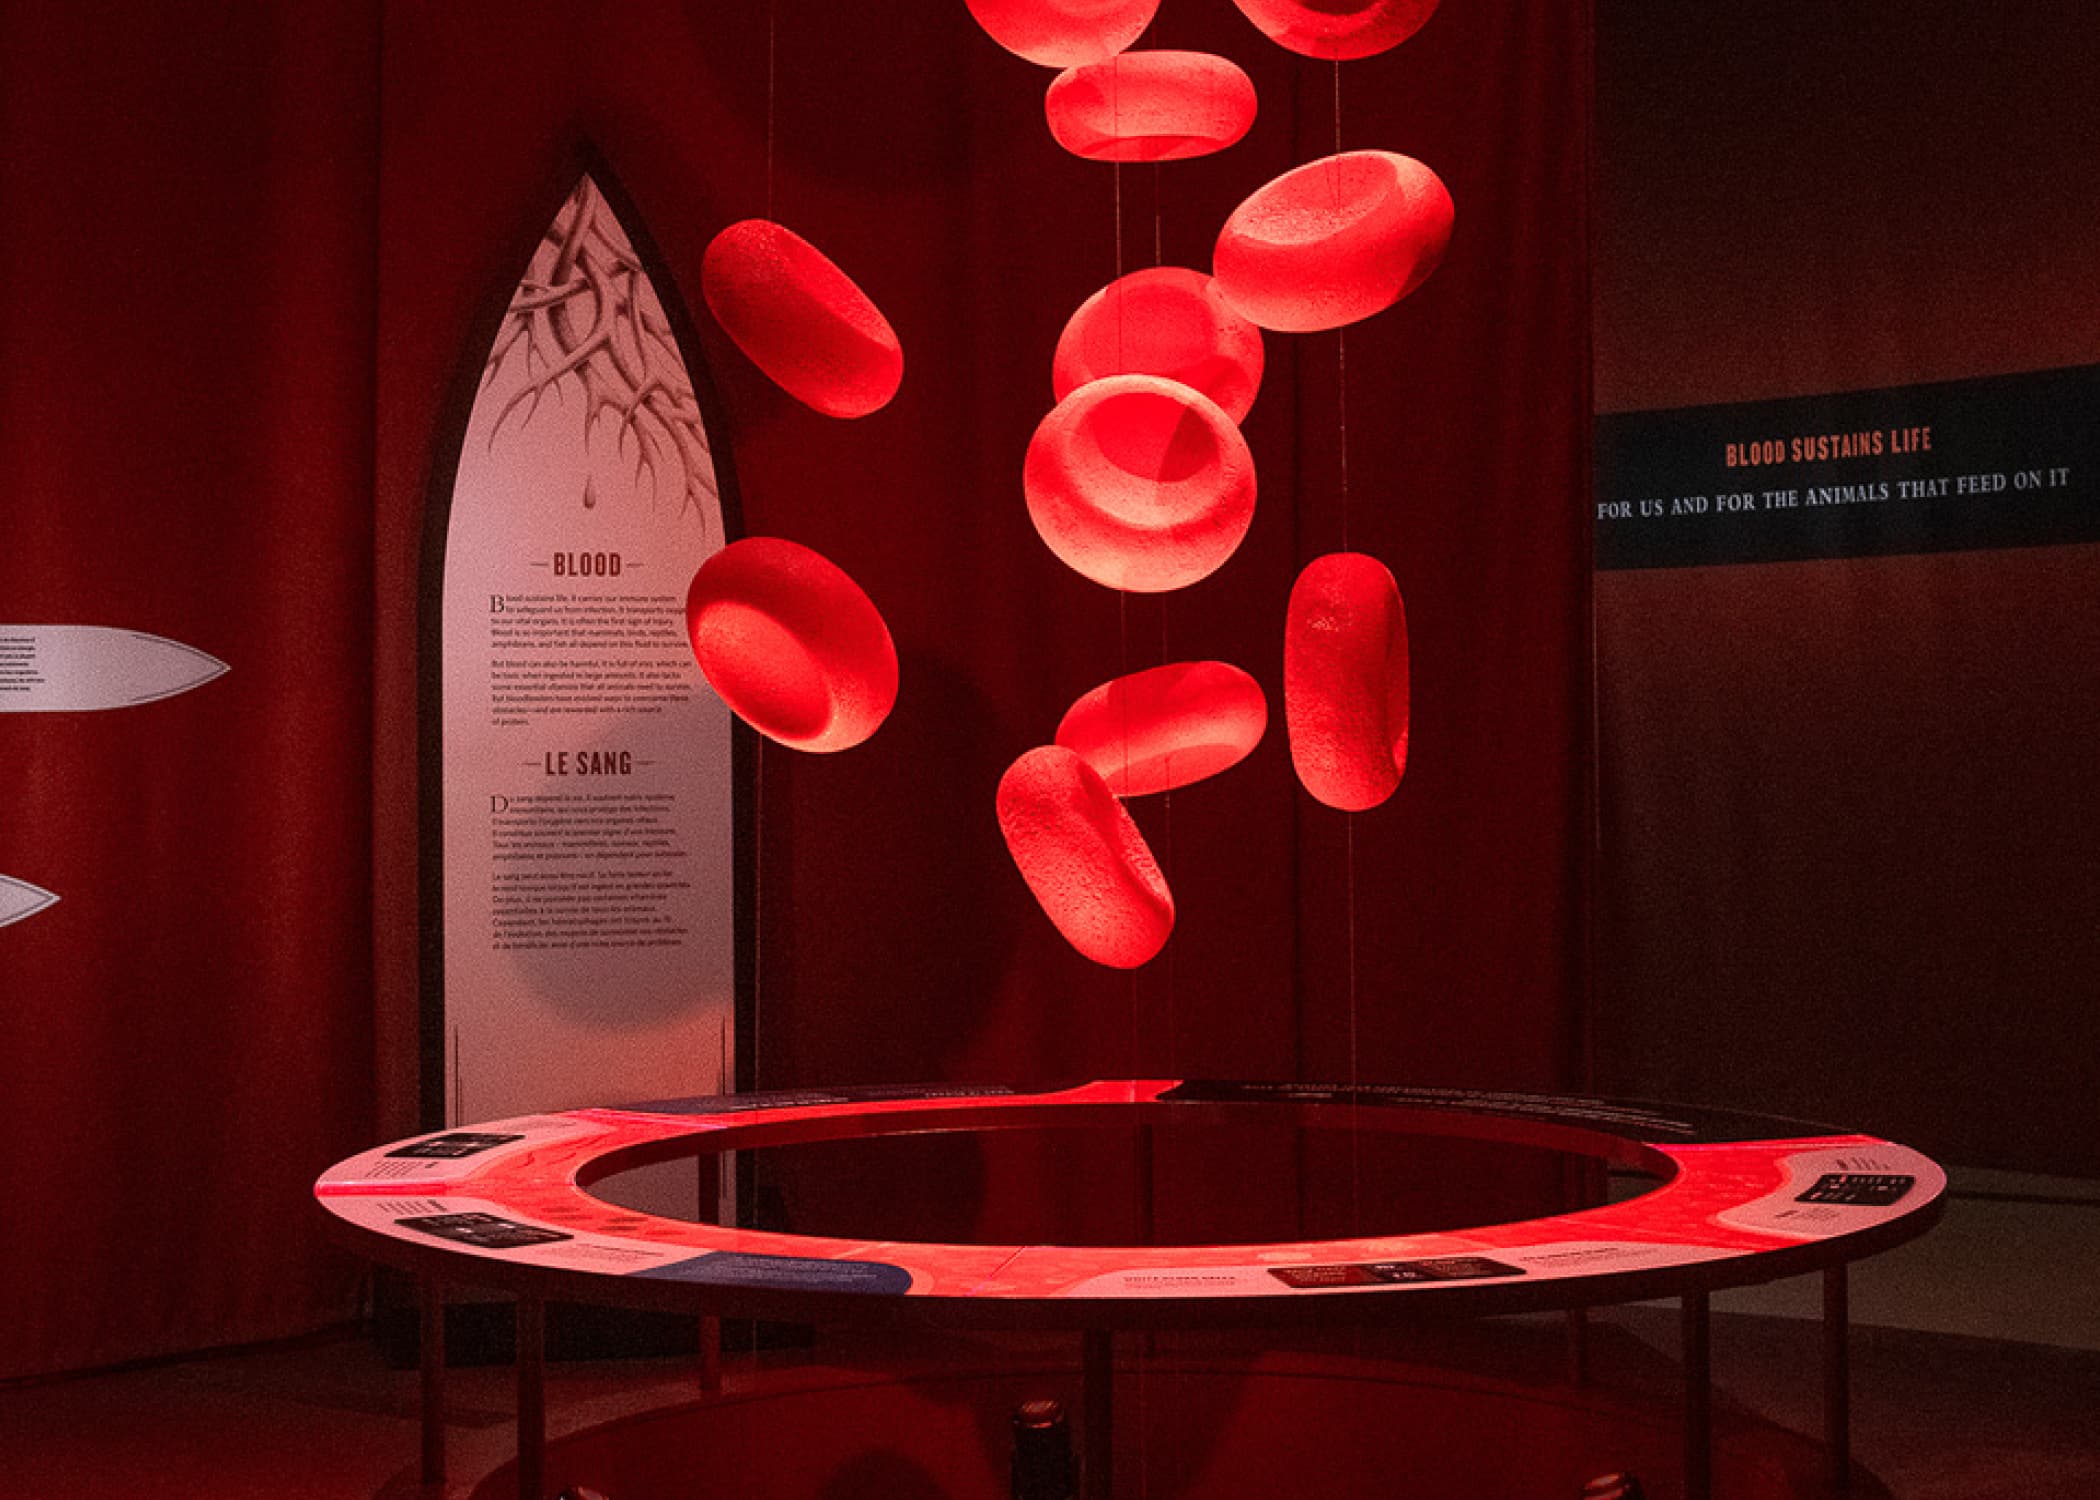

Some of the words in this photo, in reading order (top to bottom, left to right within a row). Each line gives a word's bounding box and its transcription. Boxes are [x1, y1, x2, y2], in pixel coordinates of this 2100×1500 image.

[1726, 440, 1787, 469] BLOOD
[1792, 431, 1885, 464] SUSTAINS
[1891, 427, 1932, 455] LIFE
[1598, 501, 1634, 520] FOR
[1640, 499, 1665, 518] US
[1672, 496, 1710, 516] AND
[1716, 493, 1757, 513] FOR
[1763, 490, 1800, 510] THE
[1806, 483, 1891, 507] ANIMALS
[1898, 479, 1950, 501] THAT
[1958, 474, 2008, 496] FEED
[2014, 471, 2042, 491] ON
[2050, 468, 2070, 487] IT
[554, 552, 622, 577] BLOOD
[545, 751, 570, 776] LE
[576, 751, 633, 776] SANG
